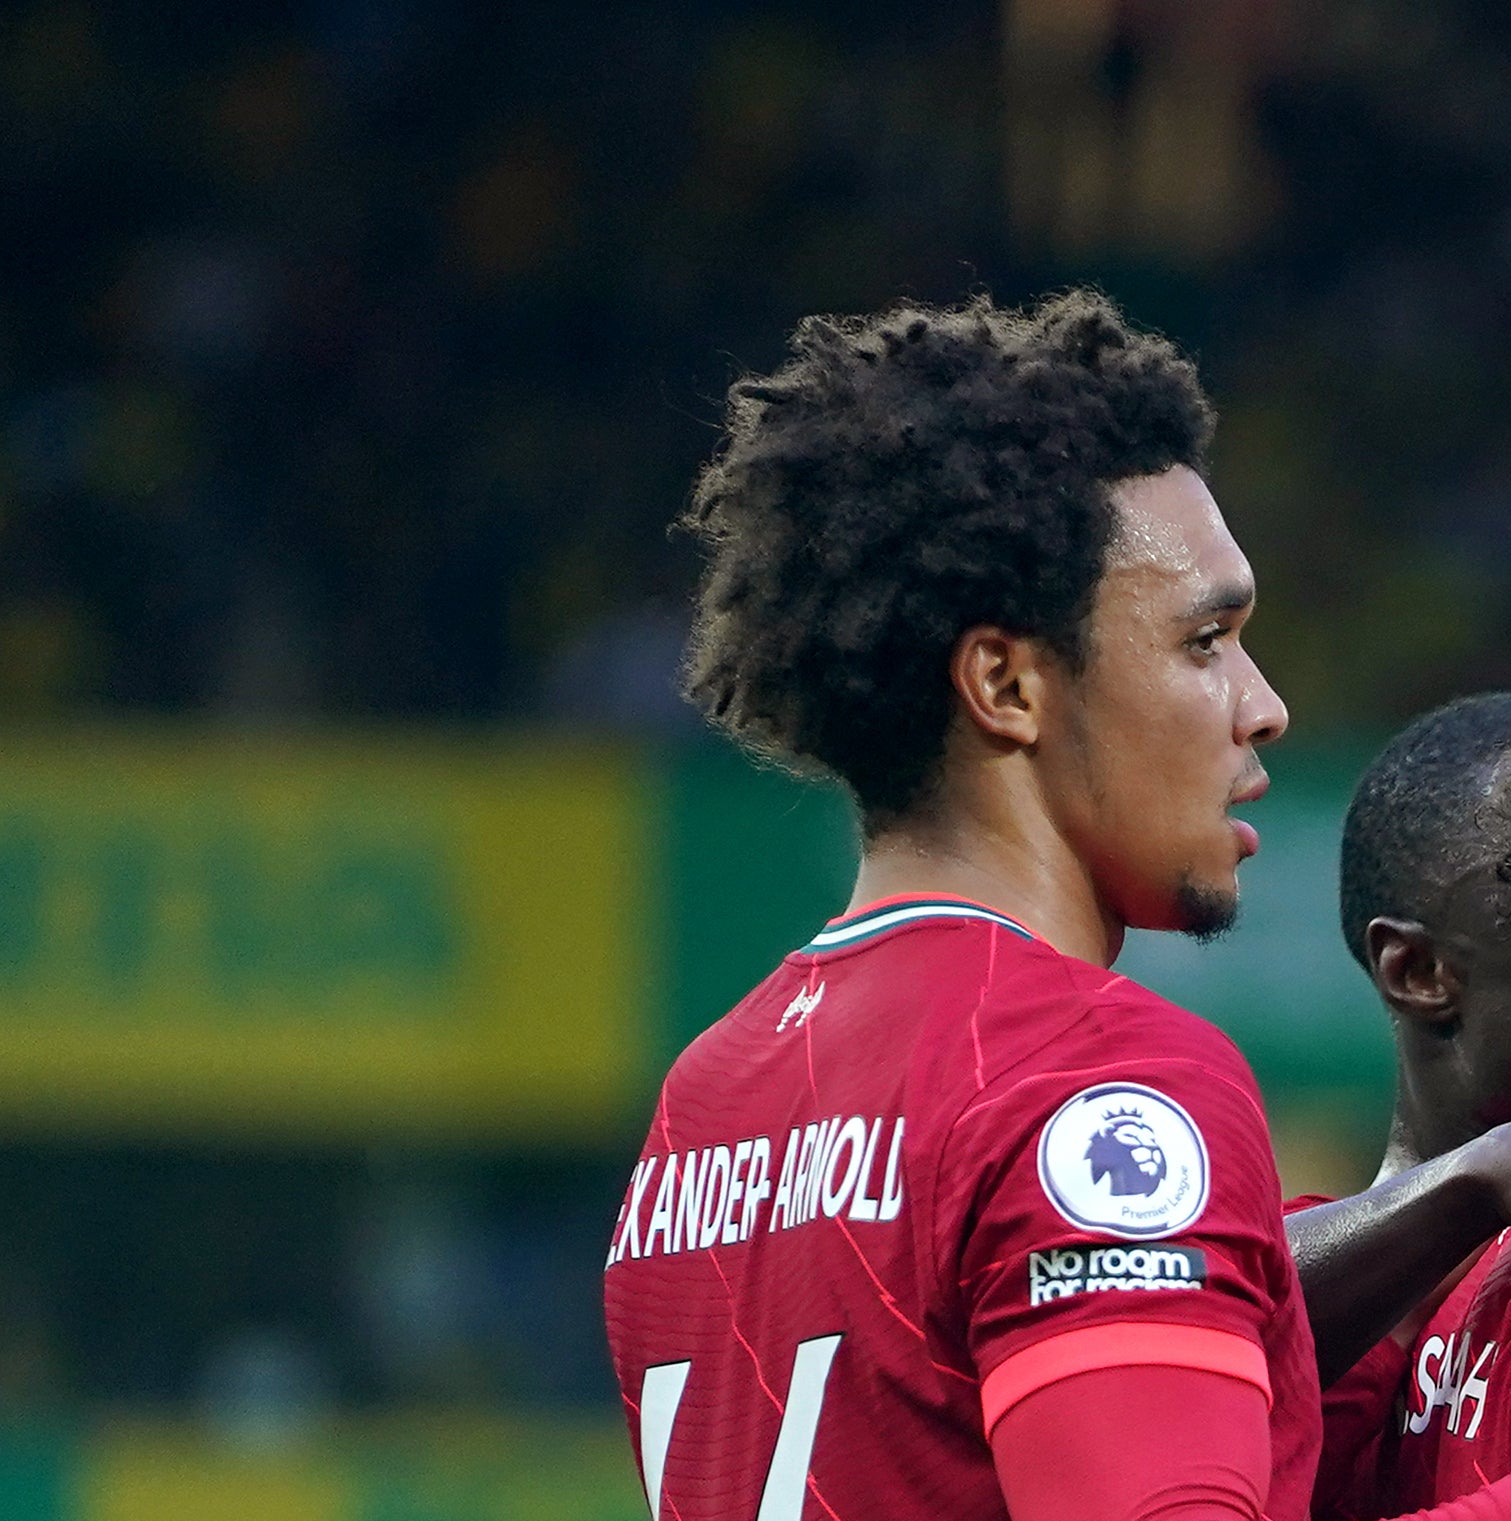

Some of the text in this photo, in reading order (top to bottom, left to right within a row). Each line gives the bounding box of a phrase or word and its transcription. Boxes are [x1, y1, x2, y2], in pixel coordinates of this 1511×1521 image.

[1121, 1164, 1194, 1219] Premier League
[1029, 1248, 1191, 1279] No room
[1030, 1275, 1083, 1307] for
